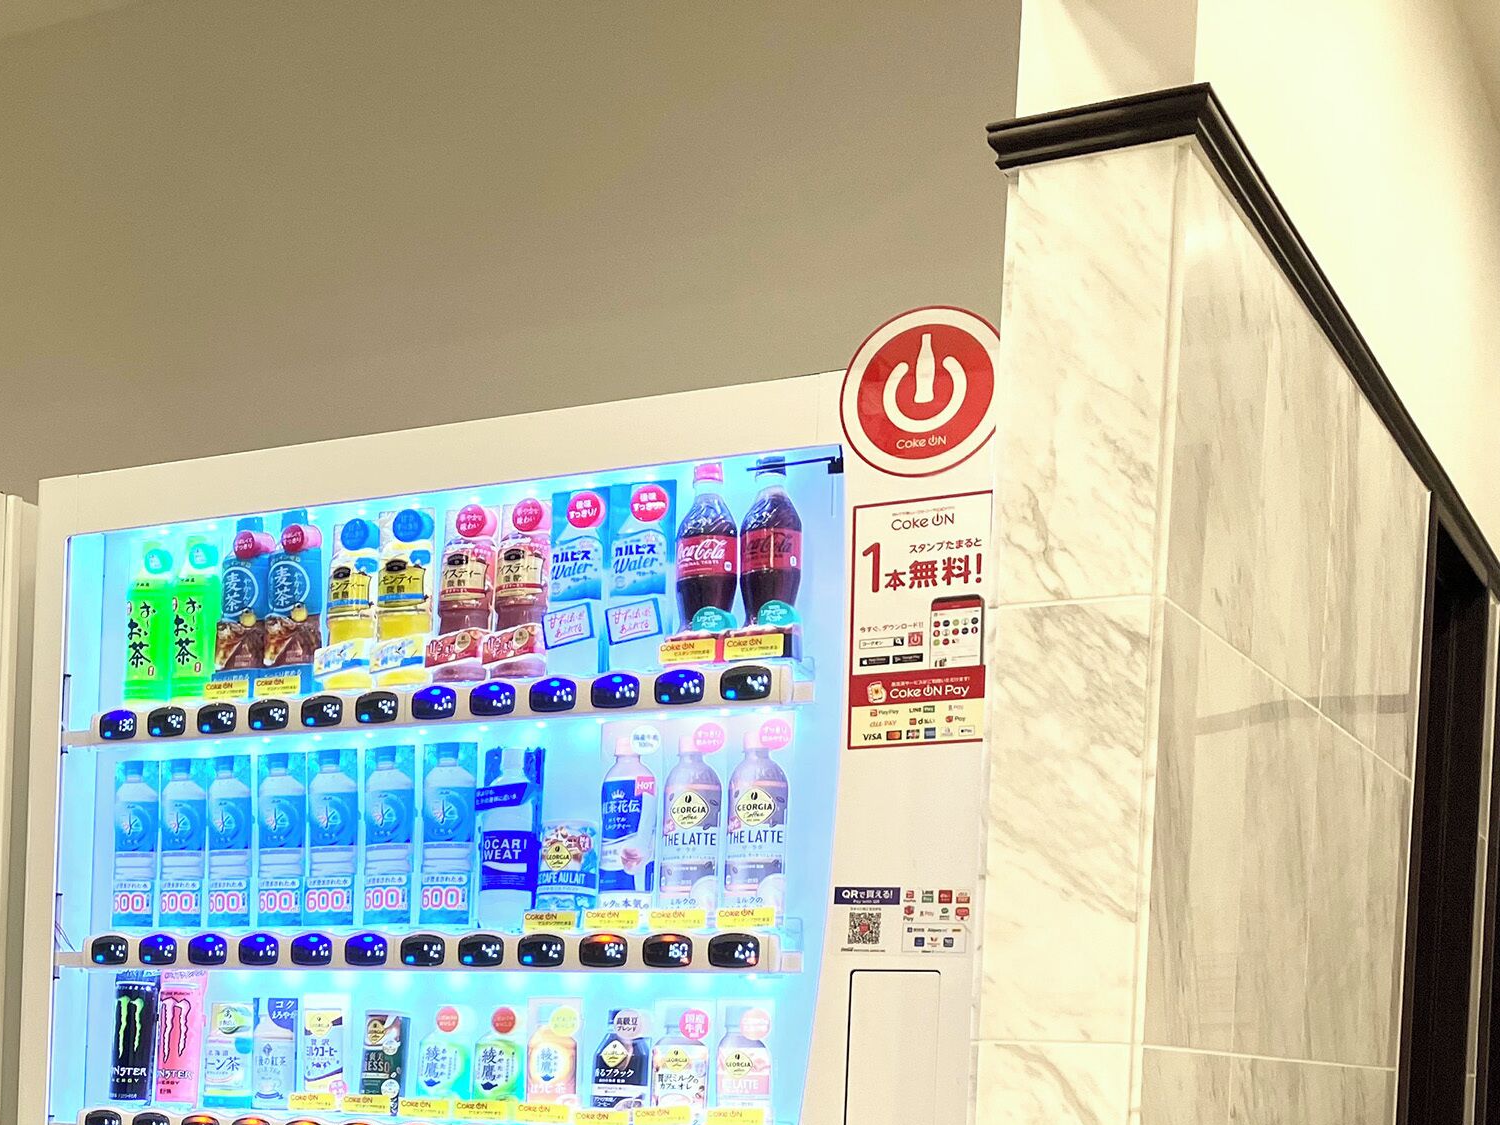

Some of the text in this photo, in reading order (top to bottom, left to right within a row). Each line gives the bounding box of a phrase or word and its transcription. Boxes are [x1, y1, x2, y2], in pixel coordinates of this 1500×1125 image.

[896, 435, 946, 449] Coke ON
[892, 513, 954, 530] Coke ON
[615, 544, 657, 557] カルピス
[909, 538, 982, 554] スタンプたまると
[552, 551, 591, 564] カルピス
[552, 562, 593, 581] Water
[613, 556, 659, 574] Water
[862, 542, 982, 592] 1本無料!
[274, 567, 294, 606] 麦茶
[380, 575, 421, 585] モンティー
[225, 572, 241, 611] 麦茶
[661, 641, 695, 652] Coke ON
[749, 638, 762, 646] ON
[890, 685, 969, 698] Coke ON Pay
[637, 782, 654, 790] HOT
[672, 806, 707, 814] GEORGIA
[737, 803, 773, 812] GEORGIA
[664, 833, 716, 846] THE LATTE
[729, 829, 784, 844] THE LATTE
[483, 839, 527, 850] OCARI
[483, 850, 522, 860] WEAT
[547, 853, 572, 861] GEORGIA
[306, 890, 345, 911] 600
[422, 888, 460, 910] 600
[842, 890, 893, 899] QRで買える!
[161, 892, 193, 912] 600
[259, 891, 293, 912] 600
[545, 912, 557, 920] ON
[607, 910, 620, 918] ON
[673, 910, 685, 918] ON
[741, 908, 754, 916] ON
[275, 1001, 294, 1009] コク
[207, 1058, 241, 1071] ーン茶
[425, 1047, 440, 1078] 綾鷹
[481, 1049, 497, 1081] 綾鷹
[111, 1067, 147, 1076] NSTER
[158, 1070, 192, 1079] NSTER
[401, 1100, 420, 1108] Coke
[635, 1110, 656, 1118] Coke
